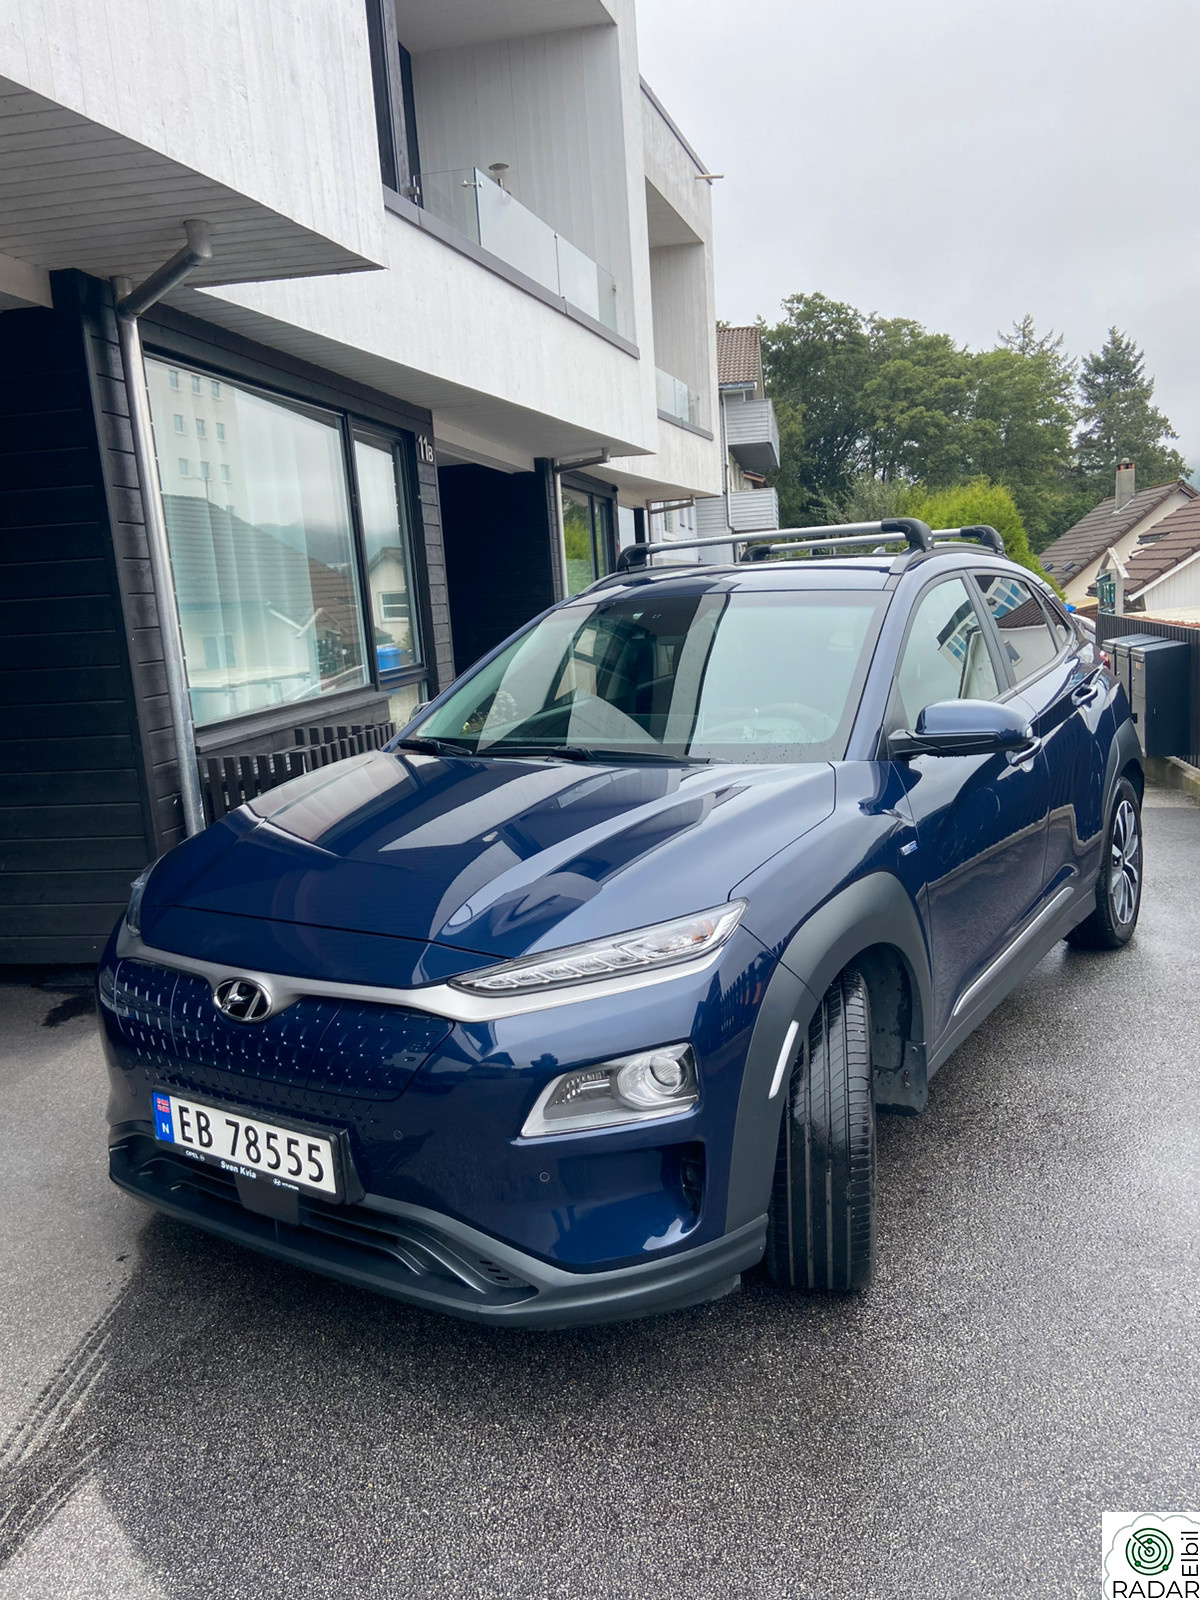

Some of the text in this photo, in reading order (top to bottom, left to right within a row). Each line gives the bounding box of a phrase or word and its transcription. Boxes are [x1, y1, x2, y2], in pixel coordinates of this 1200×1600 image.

[418, 435, 434, 462] 11B
[161, 1122, 170, 1134] N
[178, 1105, 324, 1183] EB 78555
[220, 1160, 257, 1179] Sven Kvia
